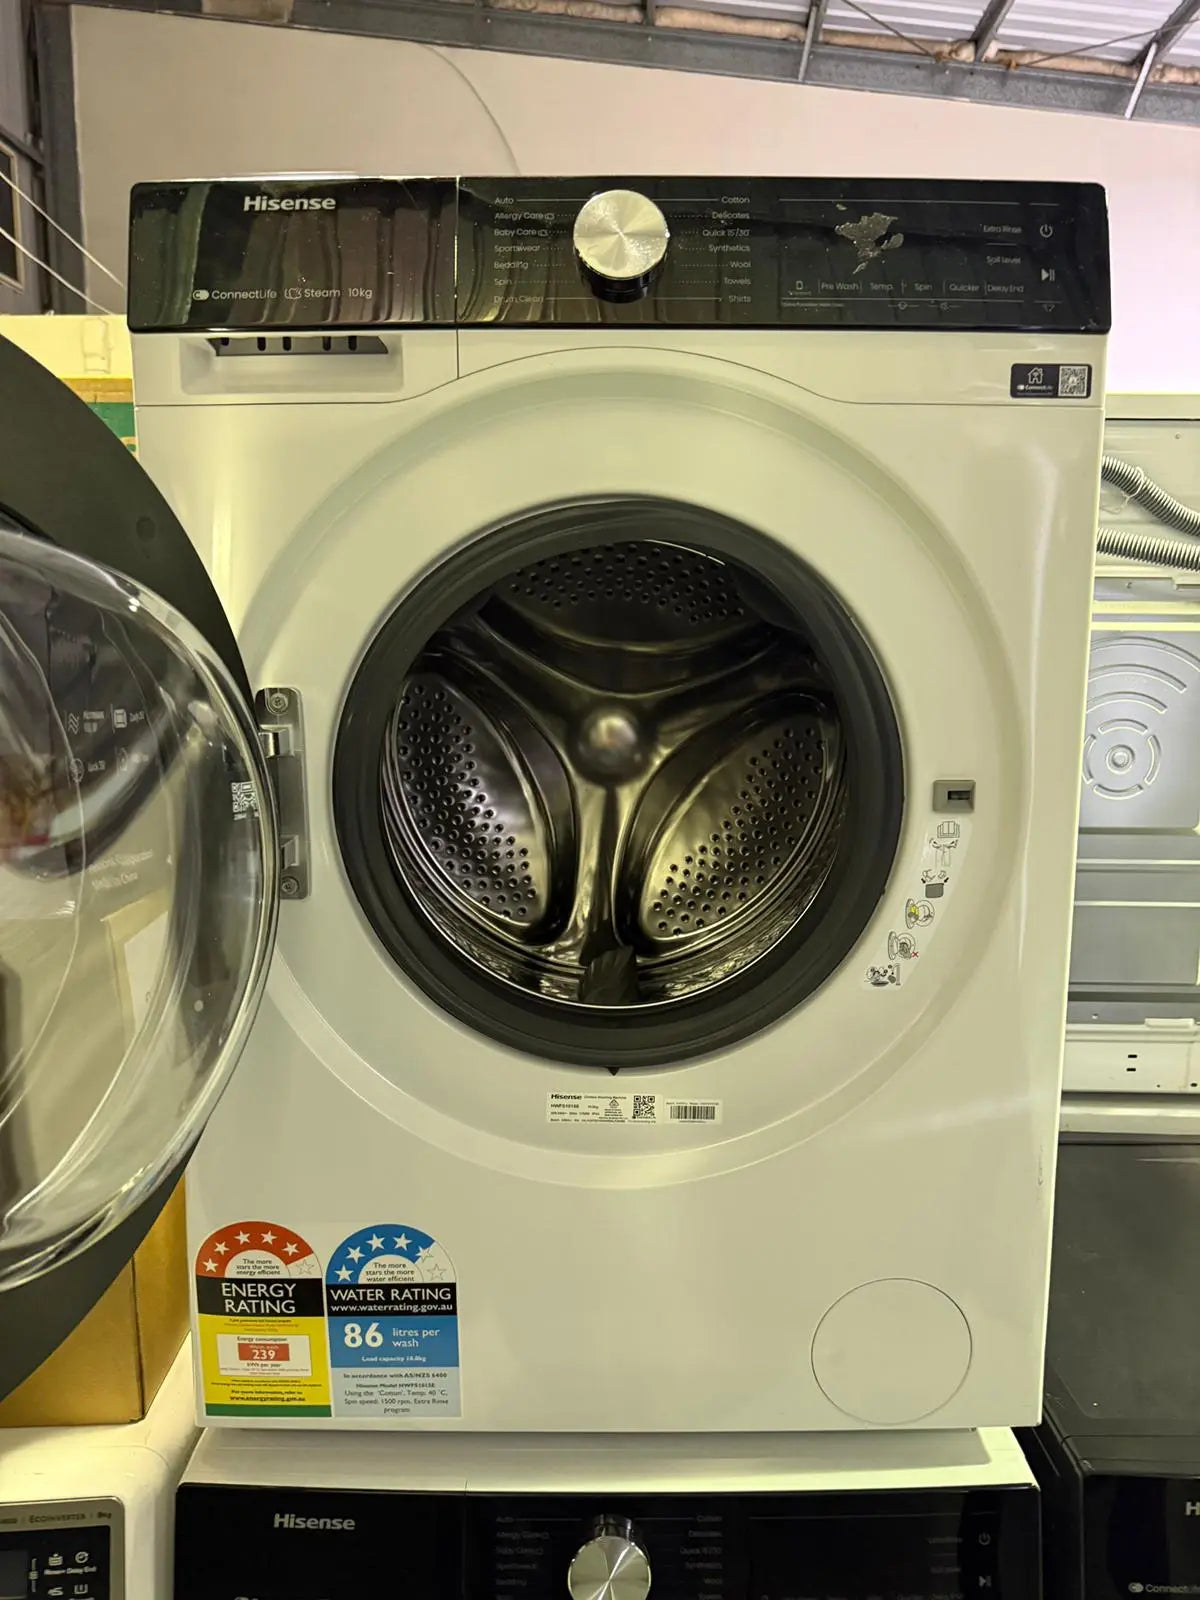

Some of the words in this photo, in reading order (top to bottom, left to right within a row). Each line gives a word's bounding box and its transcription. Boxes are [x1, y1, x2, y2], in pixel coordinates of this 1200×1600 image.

[243, 195, 337, 212] Hisense
[494, 196, 514, 205] Auto
[721, 195, 750, 204] Cotton
[494, 211, 522, 221] Allergy
[523, 211, 544, 220] Care
[711, 210, 750, 220] Delicates
[494, 228, 515, 238] Baby
[516, 228, 537, 236] Care
[702, 229, 726, 237] Quick
[494, 244, 540, 253] Sportswear
[708, 244, 751, 253] Synthetics
[493, 260, 529, 270] Bedding
[729, 260, 751, 268] Wool
[494, 278, 513, 287] Spin
[724, 277, 752, 286] Towels
[821, 282, 835, 291] Pre
[835, 282, 860, 291] Wash
[211, 289, 278, 300] ConnectLife
[303, 288, 341, 298] Steam
[348, 287, 373, 299] 10kg
[728, 295, 752, 303] Shirts
[221, 1282, 296, 1298] ENERGY
[330, 1288, 386, 1301] WATER
[391, 1287, 452, 1300] RATING
[224, 1299, 296, 1314] RATING
[330, 1302, 453, 1313] www.waterrating.gov.au
[343, 1321, 384, 1349] 86
[392, 1327, 419, 1337] litres
[421, 1328, 440, 1338] per
[391, 1338, 419, 1347] wash
[251, 1349, 276, 1360] 239
[273, 1512, 356, 1531] Hisense
